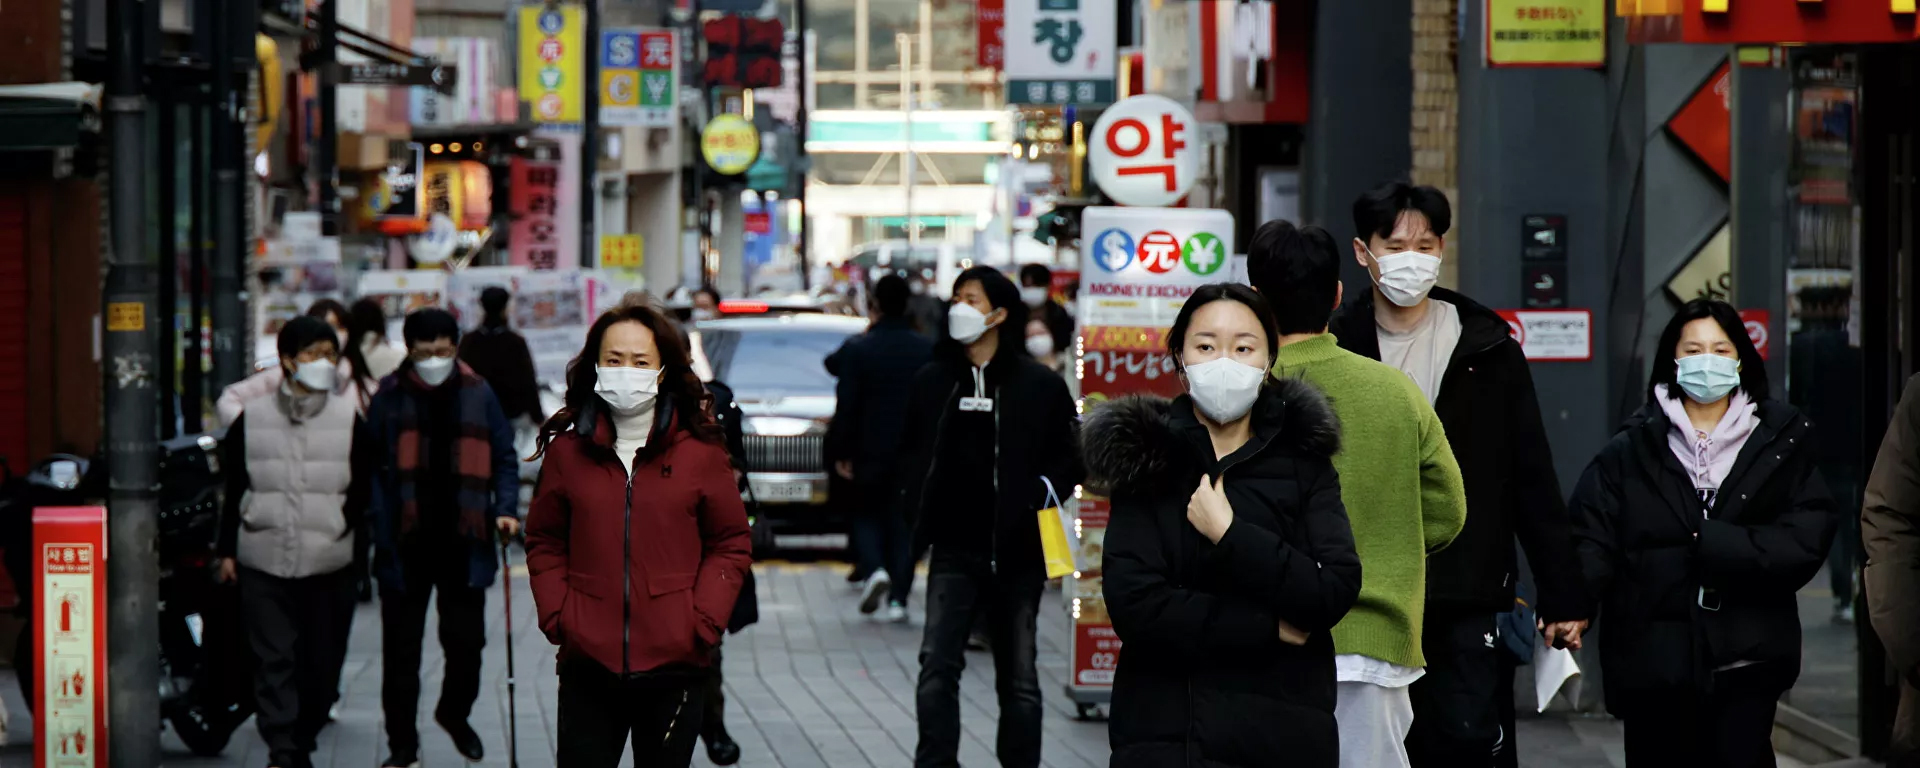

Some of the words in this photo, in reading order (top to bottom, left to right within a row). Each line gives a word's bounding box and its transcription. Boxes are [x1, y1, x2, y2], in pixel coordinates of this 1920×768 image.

[1105, 112, 1186, 193] 약
[1102, 231, 1129, 273] $
[1142, 234, 1177, 270] 元
[1189, 236, 1219, 273] ¥
[1089, 283, 1143, 296] MONEY
[1146, 284, 1194, 298] EXCHA
